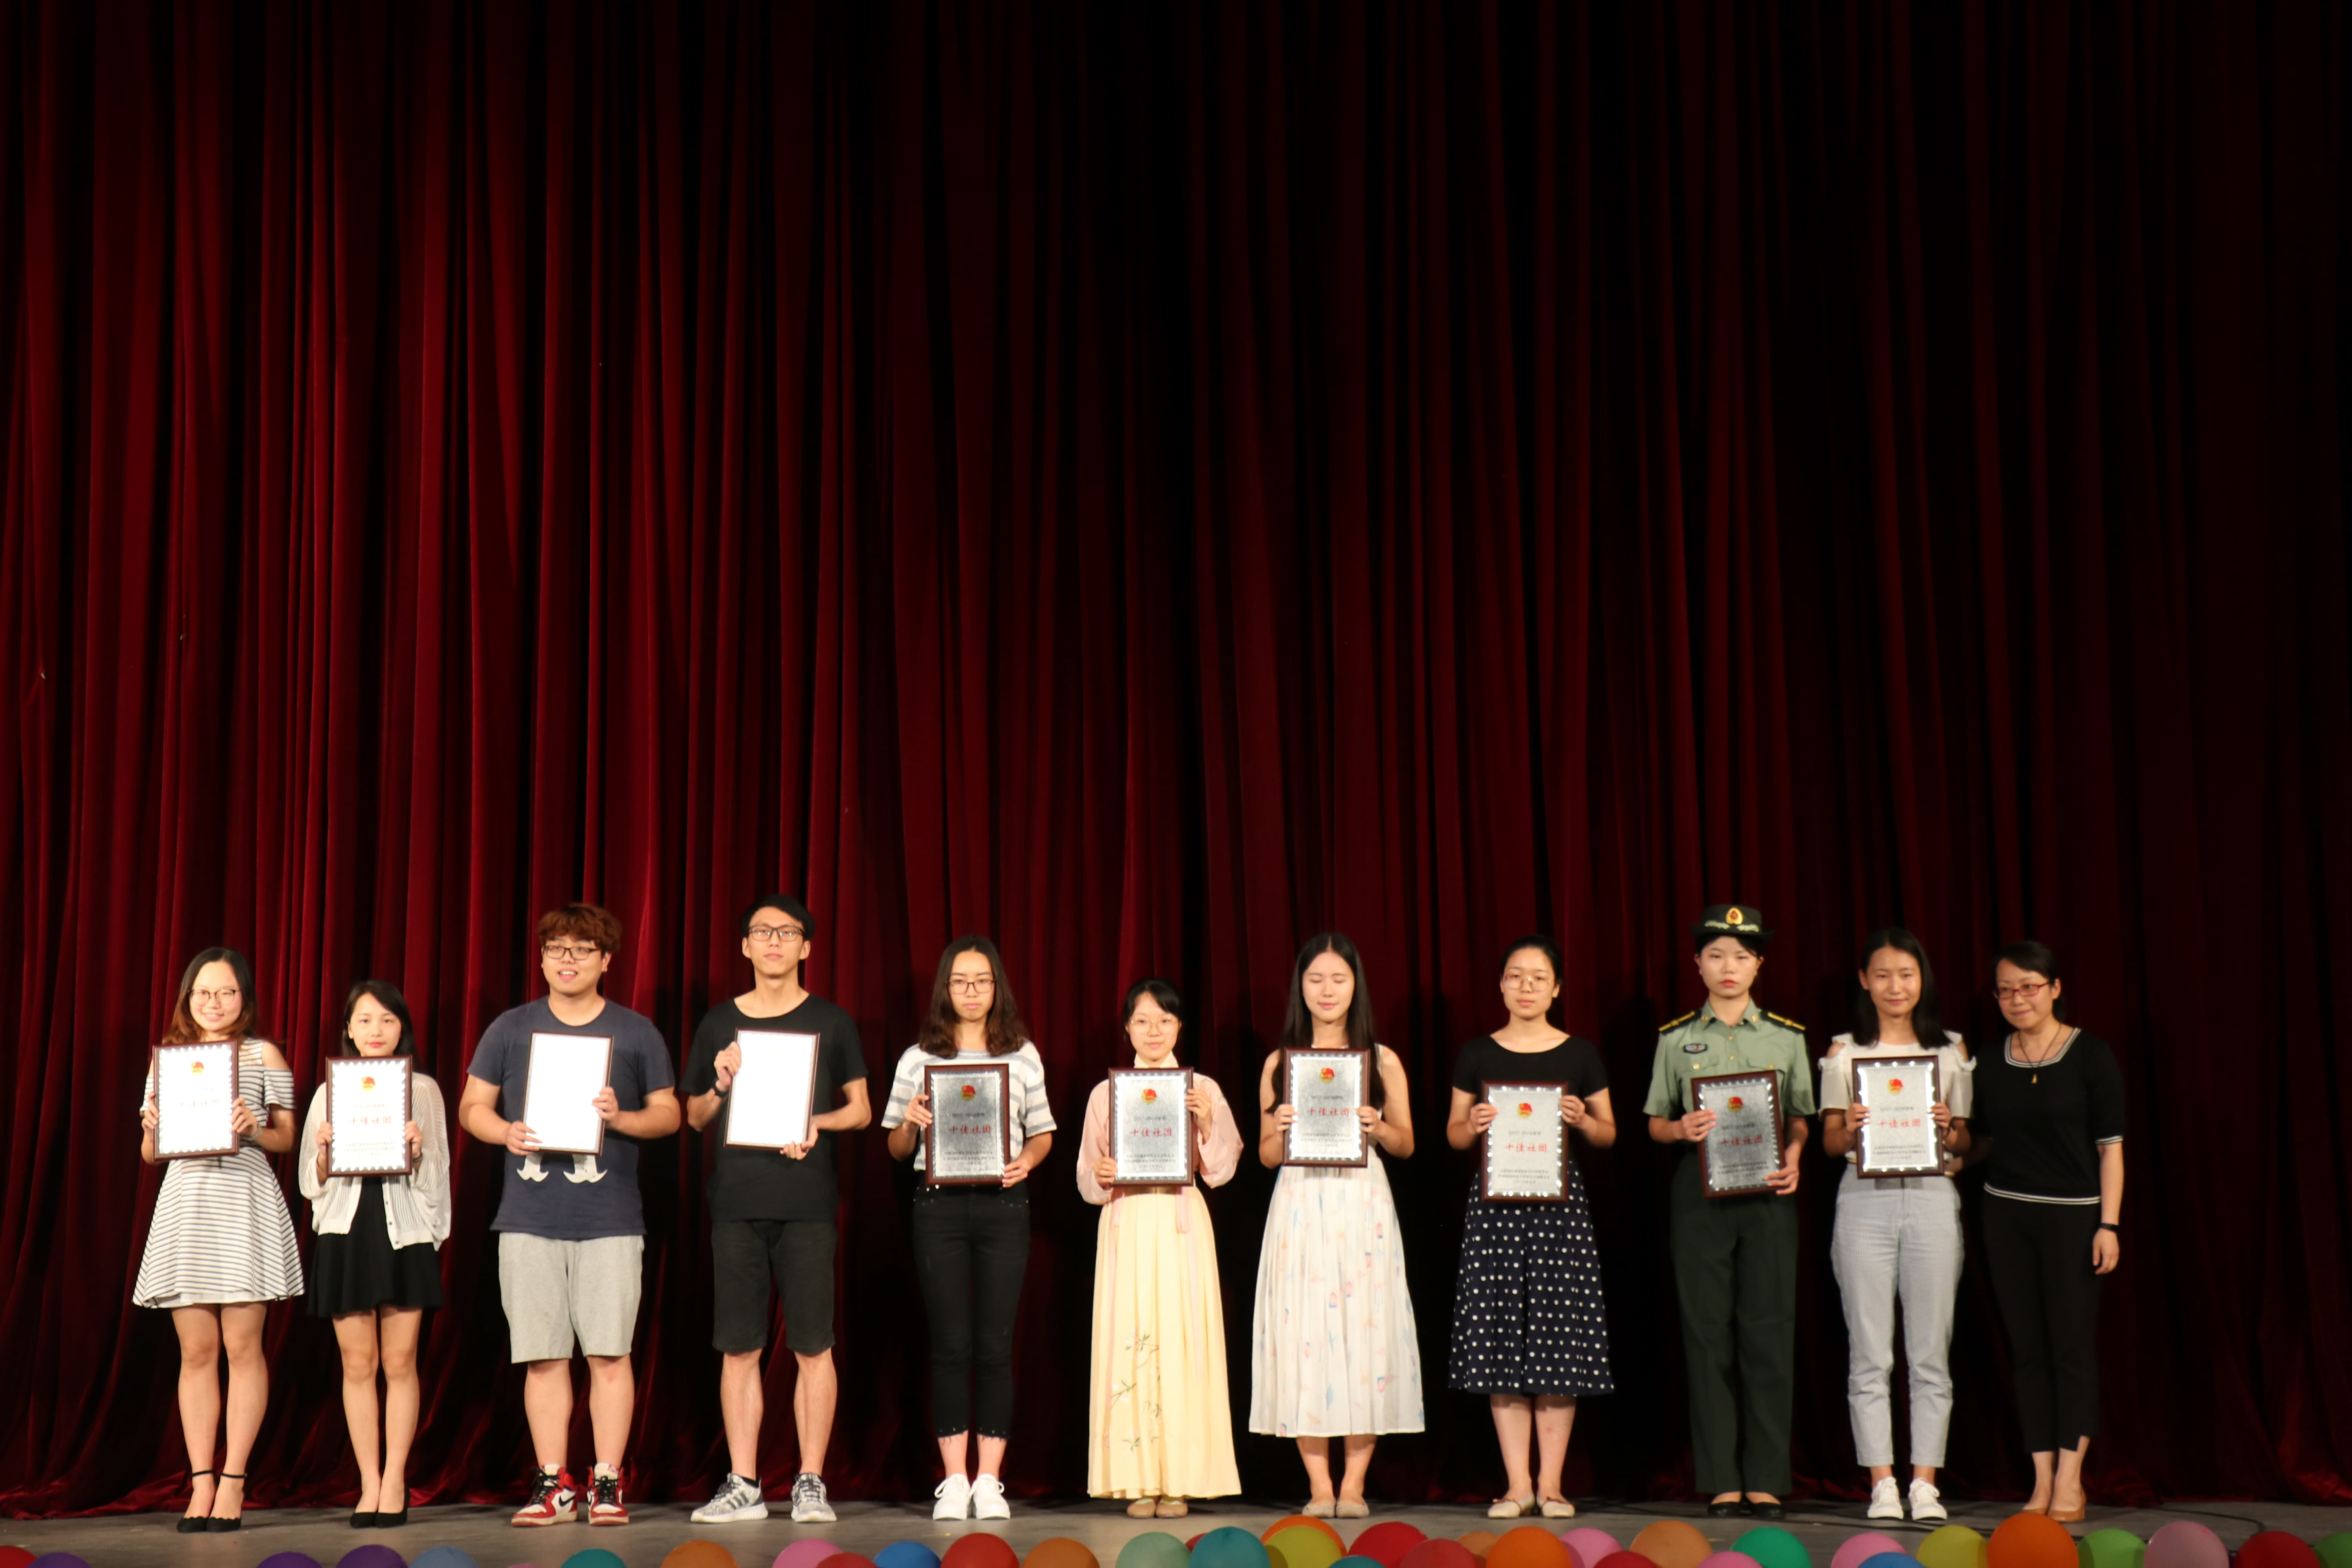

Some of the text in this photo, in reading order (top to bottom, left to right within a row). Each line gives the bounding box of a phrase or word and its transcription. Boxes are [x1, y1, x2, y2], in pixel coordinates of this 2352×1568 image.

[1307, 1107, 1349, 1116] 十佳社团
[1878, 1118, 1920, 1128] 十佳社团
[949, 1124, 991, 1134] 十佳社团
[1131, 1127, 1171, 1137] 十佳社团
[1505, 1142, 1547, 1152] 十佳社团
